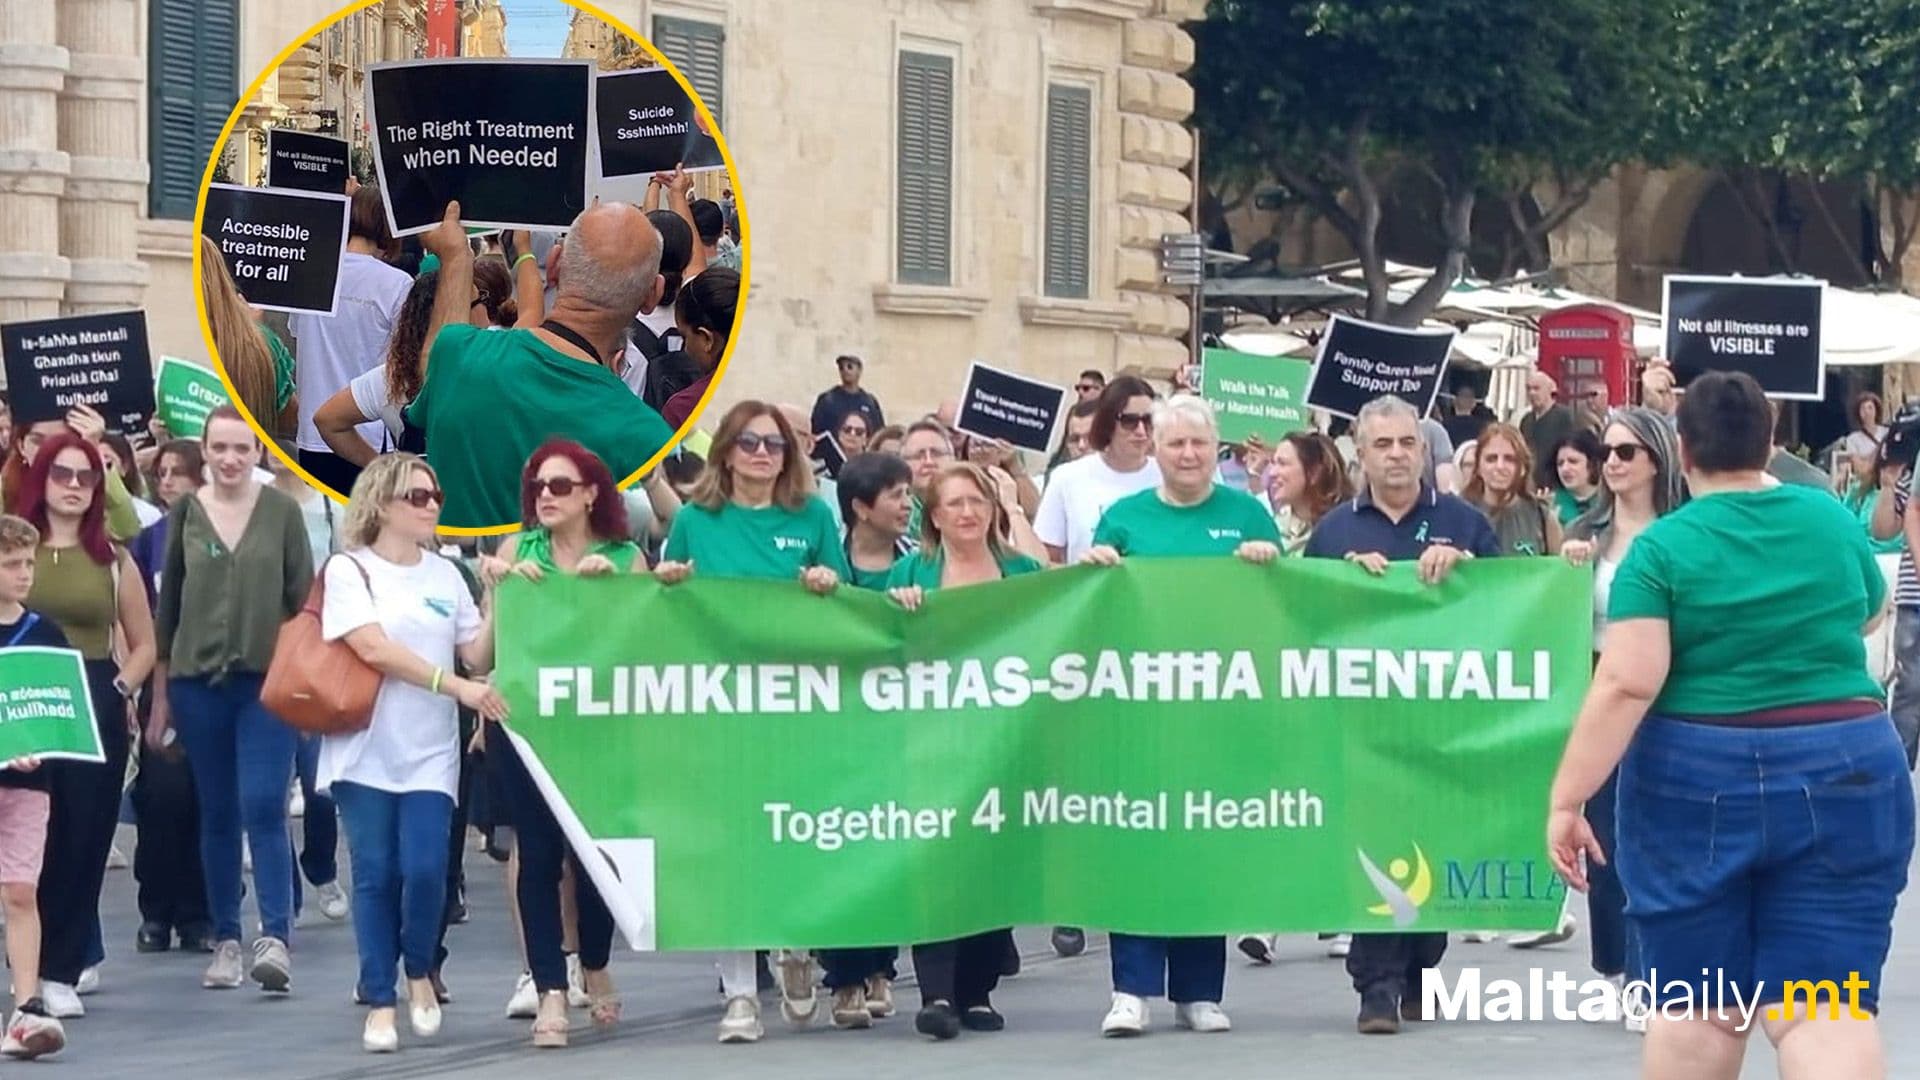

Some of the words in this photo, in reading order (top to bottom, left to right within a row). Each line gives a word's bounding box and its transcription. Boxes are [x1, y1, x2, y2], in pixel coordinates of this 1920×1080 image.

[628, 105, 675, 121] Suicide
[387, 125, 417, 143] The
[422, 121, 472, 141] Right
[476, 120, 575, 140] Treatment
[293, 161, 329, 173] VISIBLE
[403, 147, 460, 170] when
[469, 144, 558, 168] Needed
[221, 218, 310, 241] Accessible
[222, 238, 306, 261] treatment
[235, 260, 262, 279] for
[266, 264, 289, 282] all
[79, 327, 128, 344] Mentali
[1678, 317, 1703, 333] Not
[1705, 318, 1722, 334] all
[1785, 325, 1810, 338] are
[91, 350, 121, 363] tkun
[1709, 336, 1775, 355] VISIBLE
[1334, 349, 1375, 374] Family
[1375, 361, 1411, 377] Carers
[1220, 377, 1247, 396] Walk
[1248, 382, 1265, 397] the
[1266, 383, 1291, 401] Talk
[1341, 368, 1400, 393] Support
[1401, 377, 1422, 393] Too
[1227, 400, 1264, 417] Mental
[1265, 404, 1300, 422] Health
[537, 663, 841, 717] FLIMKIEN
[1279, 648, 1552, 701] MENTALI
[763, 799, 957, 851] Together
[972, 786, 1006, 835] 4
[1022, 787, 1169, 831] Mental
[1183, 788, 1325, 830] Health
[1445, 858, 1568, 901] MHA
